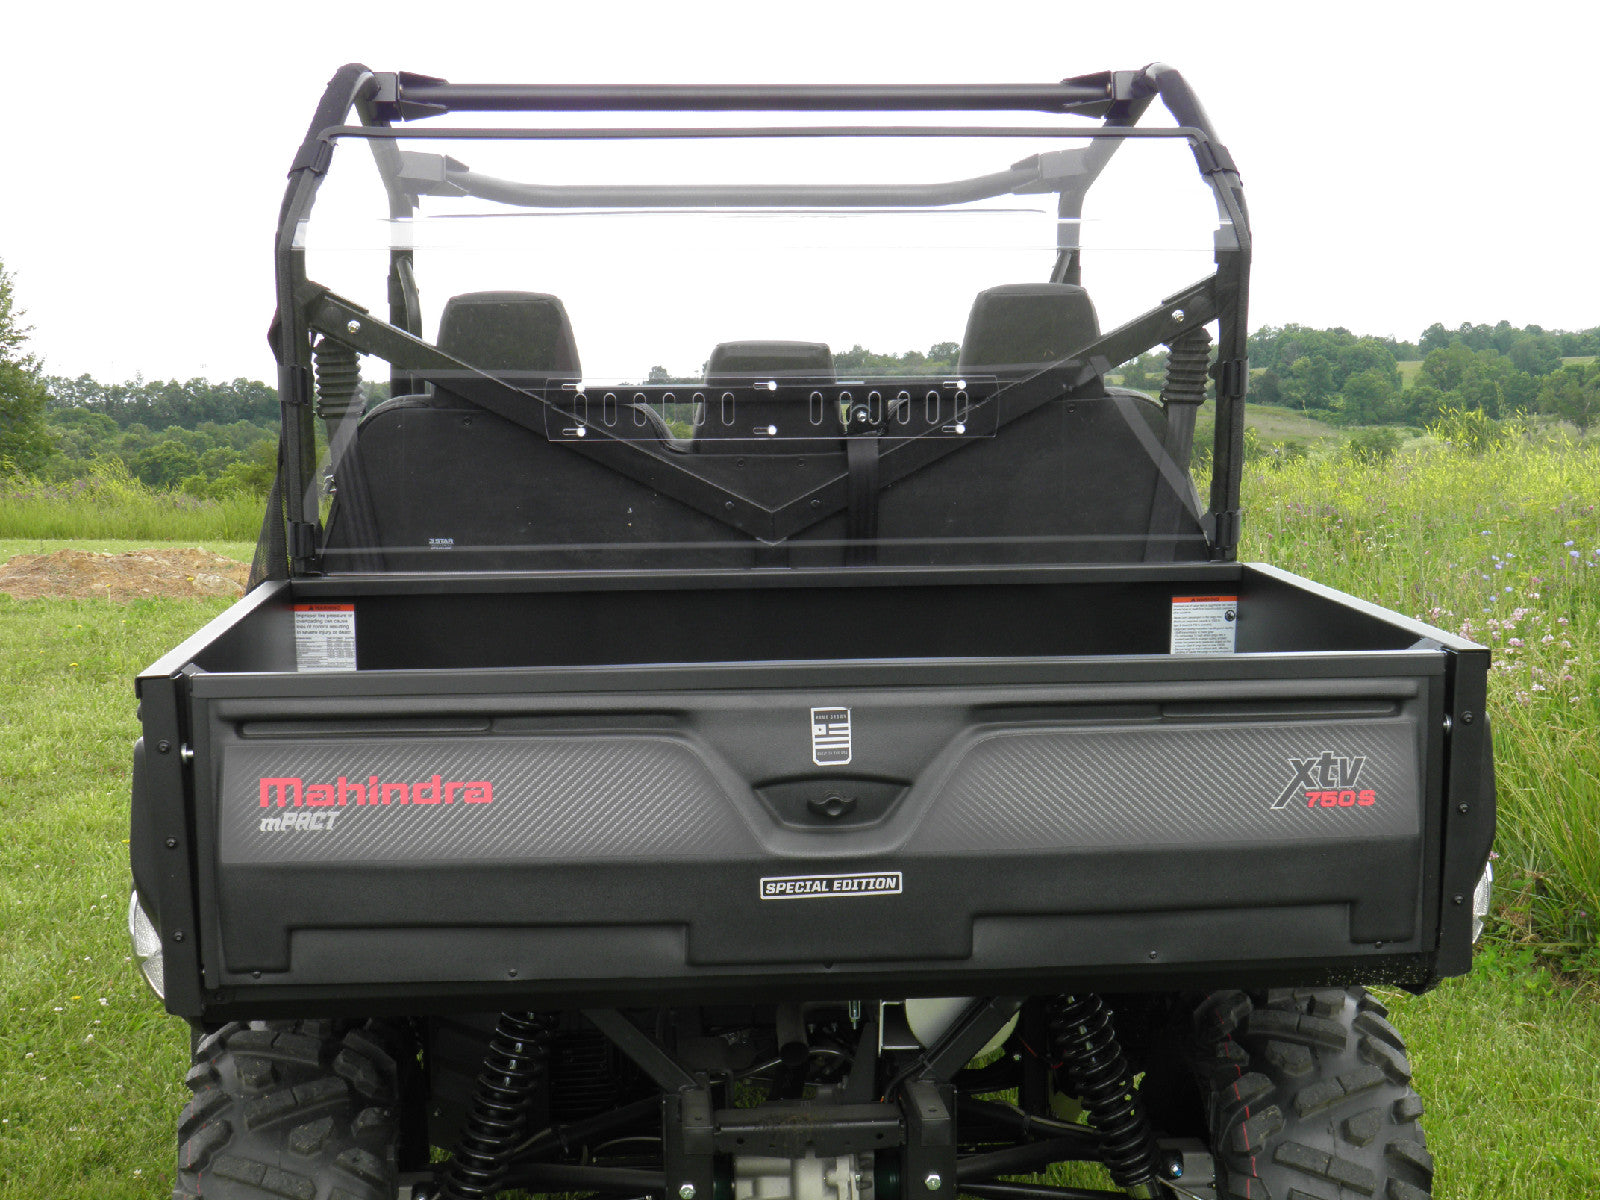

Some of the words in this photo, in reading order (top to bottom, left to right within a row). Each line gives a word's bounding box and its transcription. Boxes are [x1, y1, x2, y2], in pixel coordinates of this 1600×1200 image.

[259, 774, 493, 807] Mahindra
[765, 880, 830, 894] SPECIAL
[833, 877, 897, 891] EDITION
